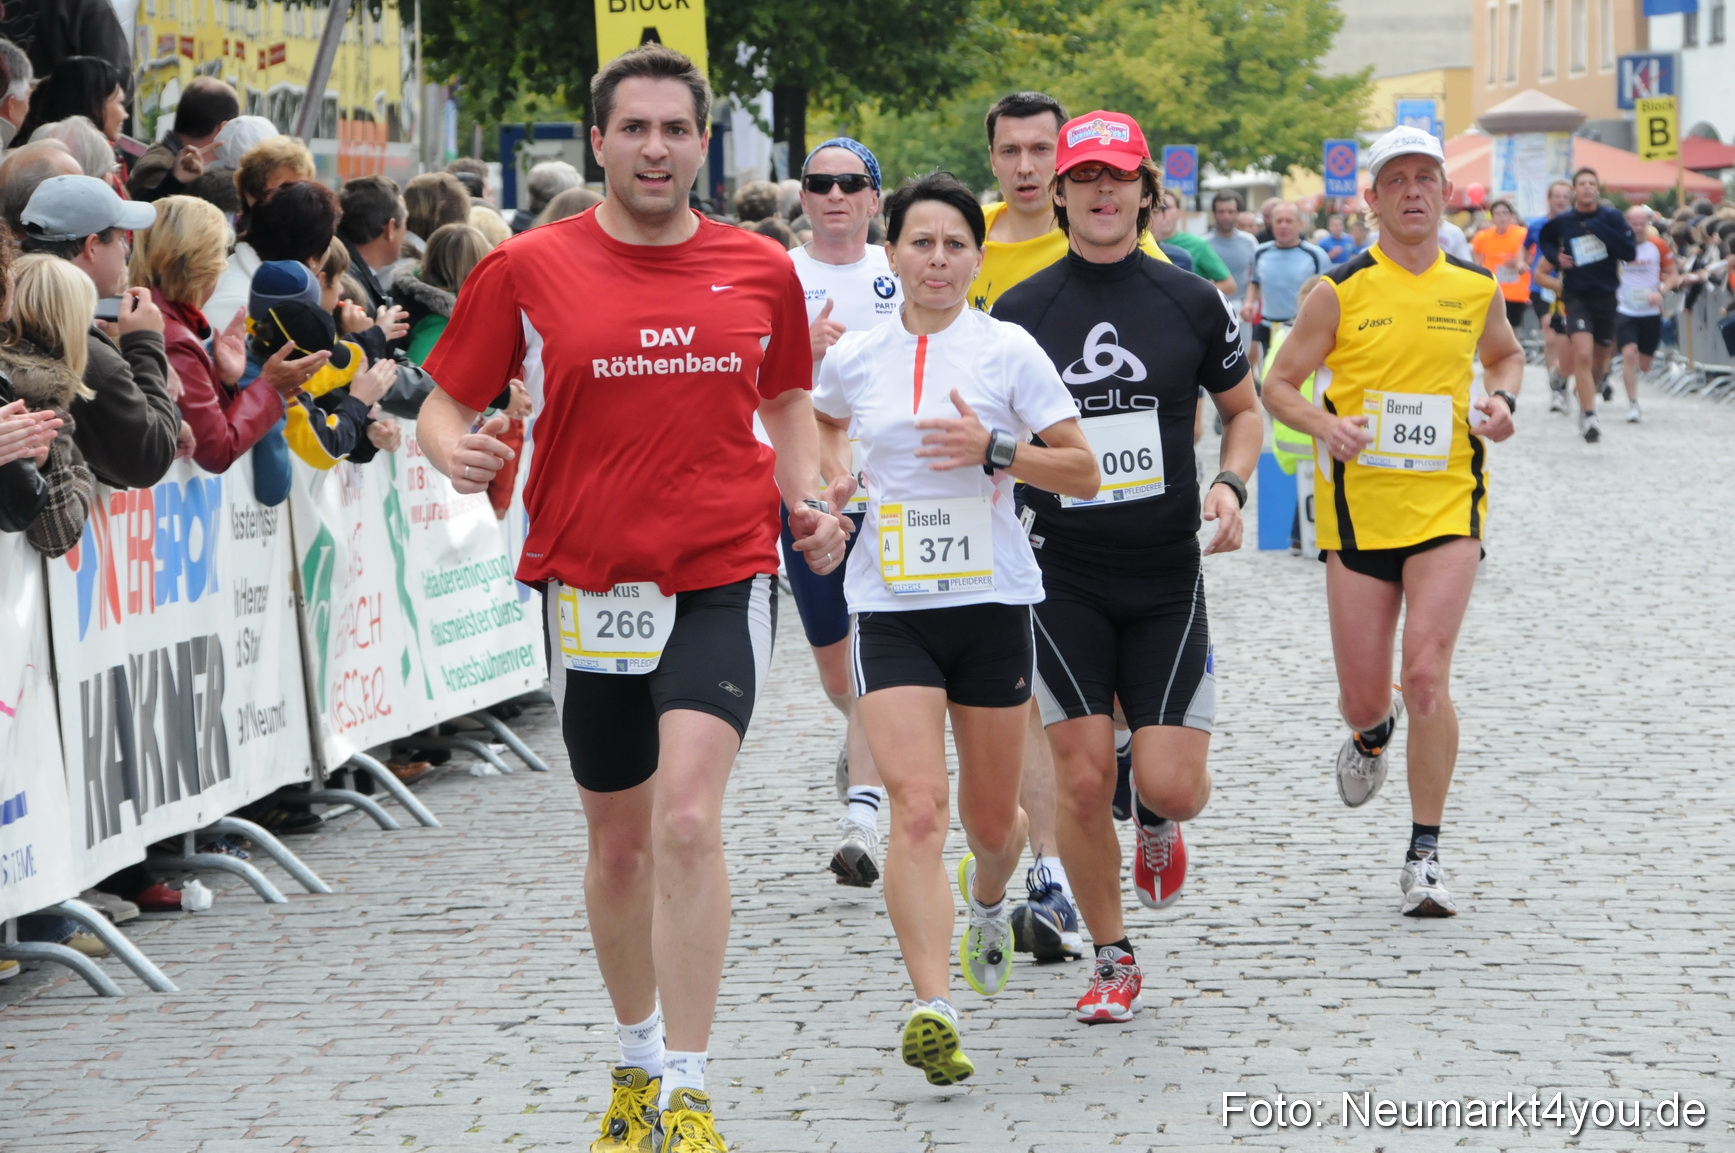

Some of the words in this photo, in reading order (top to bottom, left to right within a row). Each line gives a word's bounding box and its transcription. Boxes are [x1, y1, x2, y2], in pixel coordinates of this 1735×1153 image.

[1642, 101, 1675, 112] Block
[1649, 117, 1670, 146] B
[1369, 317, 1393, 328] asics
[640, 326, 696, 347] DAV
[592, 352, 742, 379] Röthenbach
[1073, 389, 1159, 411] dlo
[1386, 399, 1422, 415] Bernd
[1393, 423, 1436, 446] 849
[1093, 447, 1153, 476] 006
[1124, 482, 1163, 496] PFLEIDERER
[907, 508, 951, 527] Gisela
[884, 539, 891, 552] A
[919, 535, 970, 563] 371
[950, 576, 993, 587] PFLEIDERER
[561, 607, 566, 621] A
[596, 610, 655, 639] 266
[79, 632, 232, 850] HAKNER
